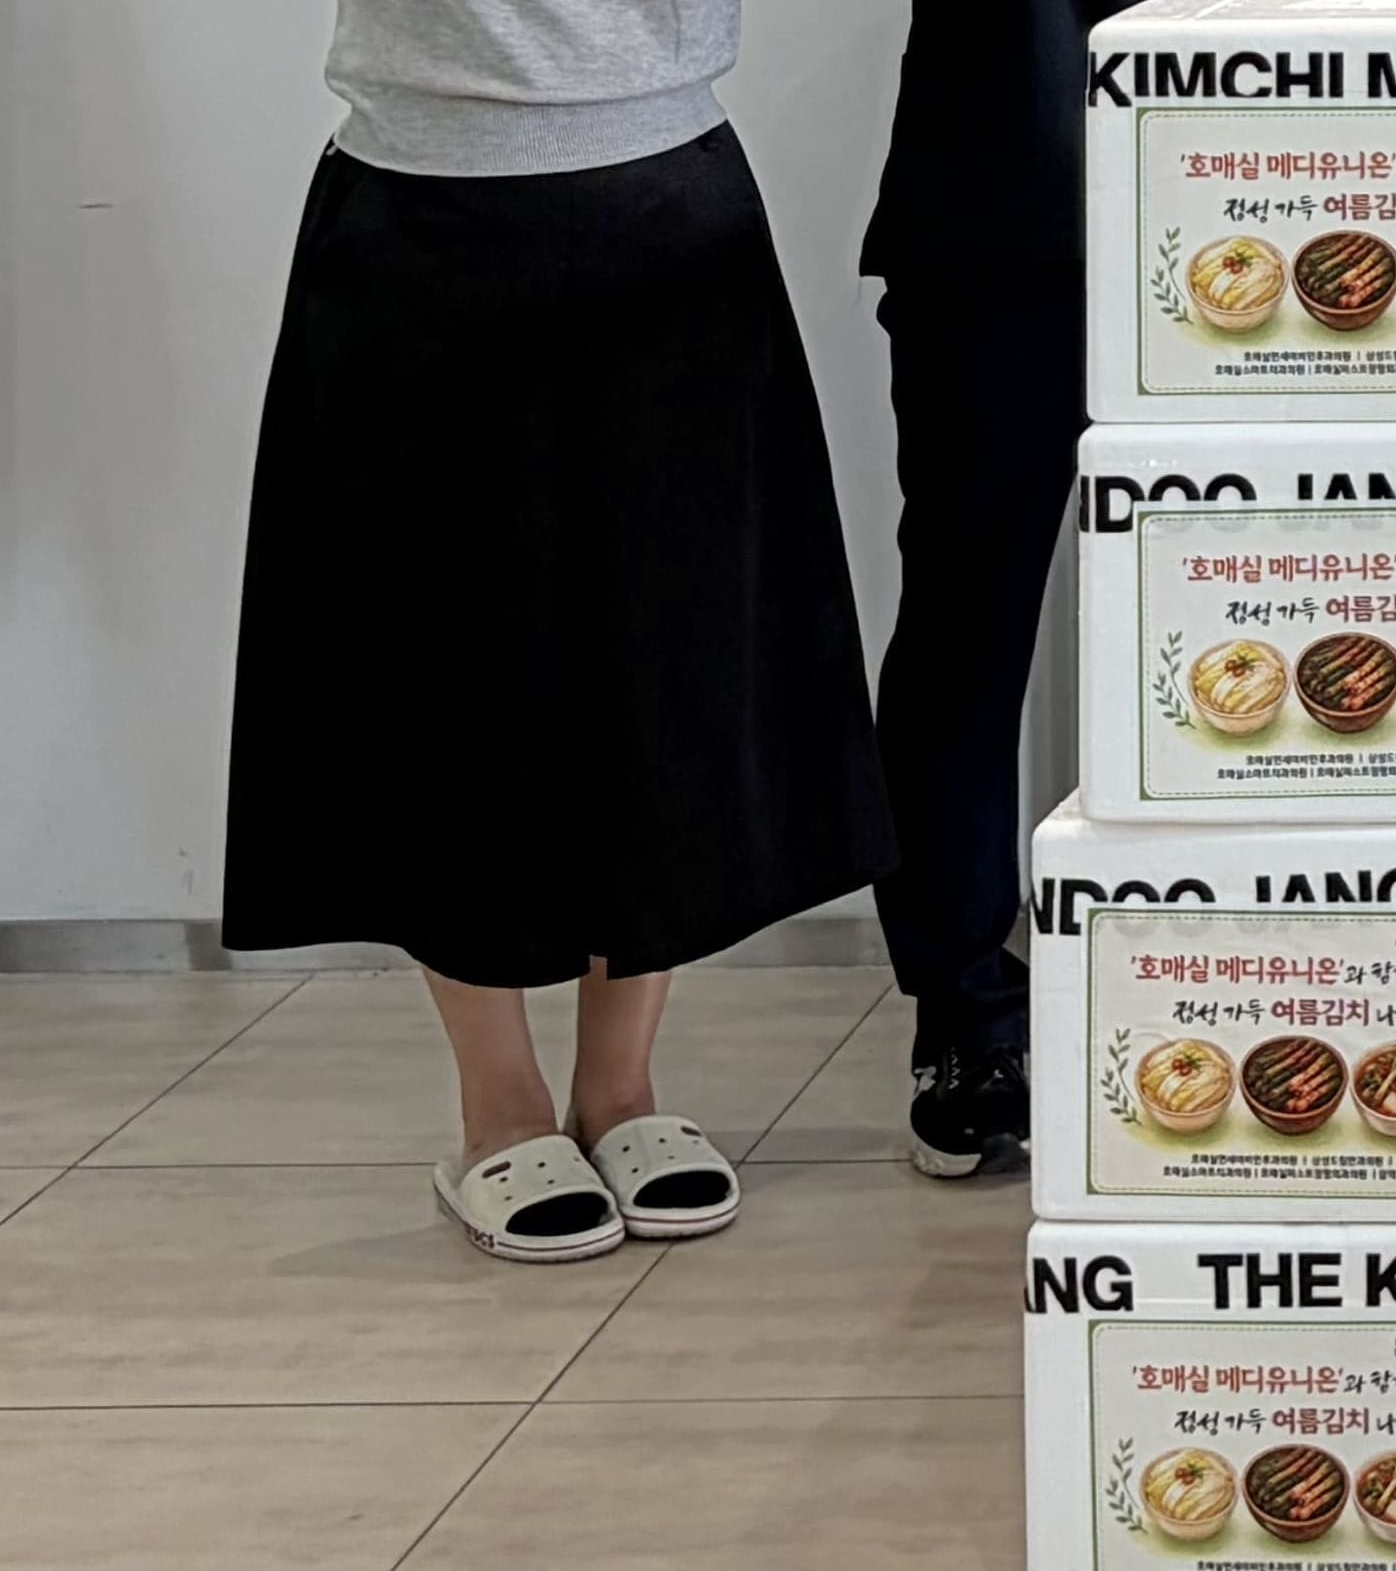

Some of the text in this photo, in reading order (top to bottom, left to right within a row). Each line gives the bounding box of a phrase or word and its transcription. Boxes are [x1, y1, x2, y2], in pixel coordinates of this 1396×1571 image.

[1088, 51, 1344, 107] KIMCHI
[1223, 197, 1270, 224] 정성
[1225, 601, 1272, 627] 정성
[1172, 1000, 1219, 1027] 정성
[1270, 997, 1370, 1027] 여름김치
[1197, 1252, 1345, 1310] THE
[1174, 1410, 1220, 1437] 정성
[1271, 1406, 1370, 1436] 여름김치
